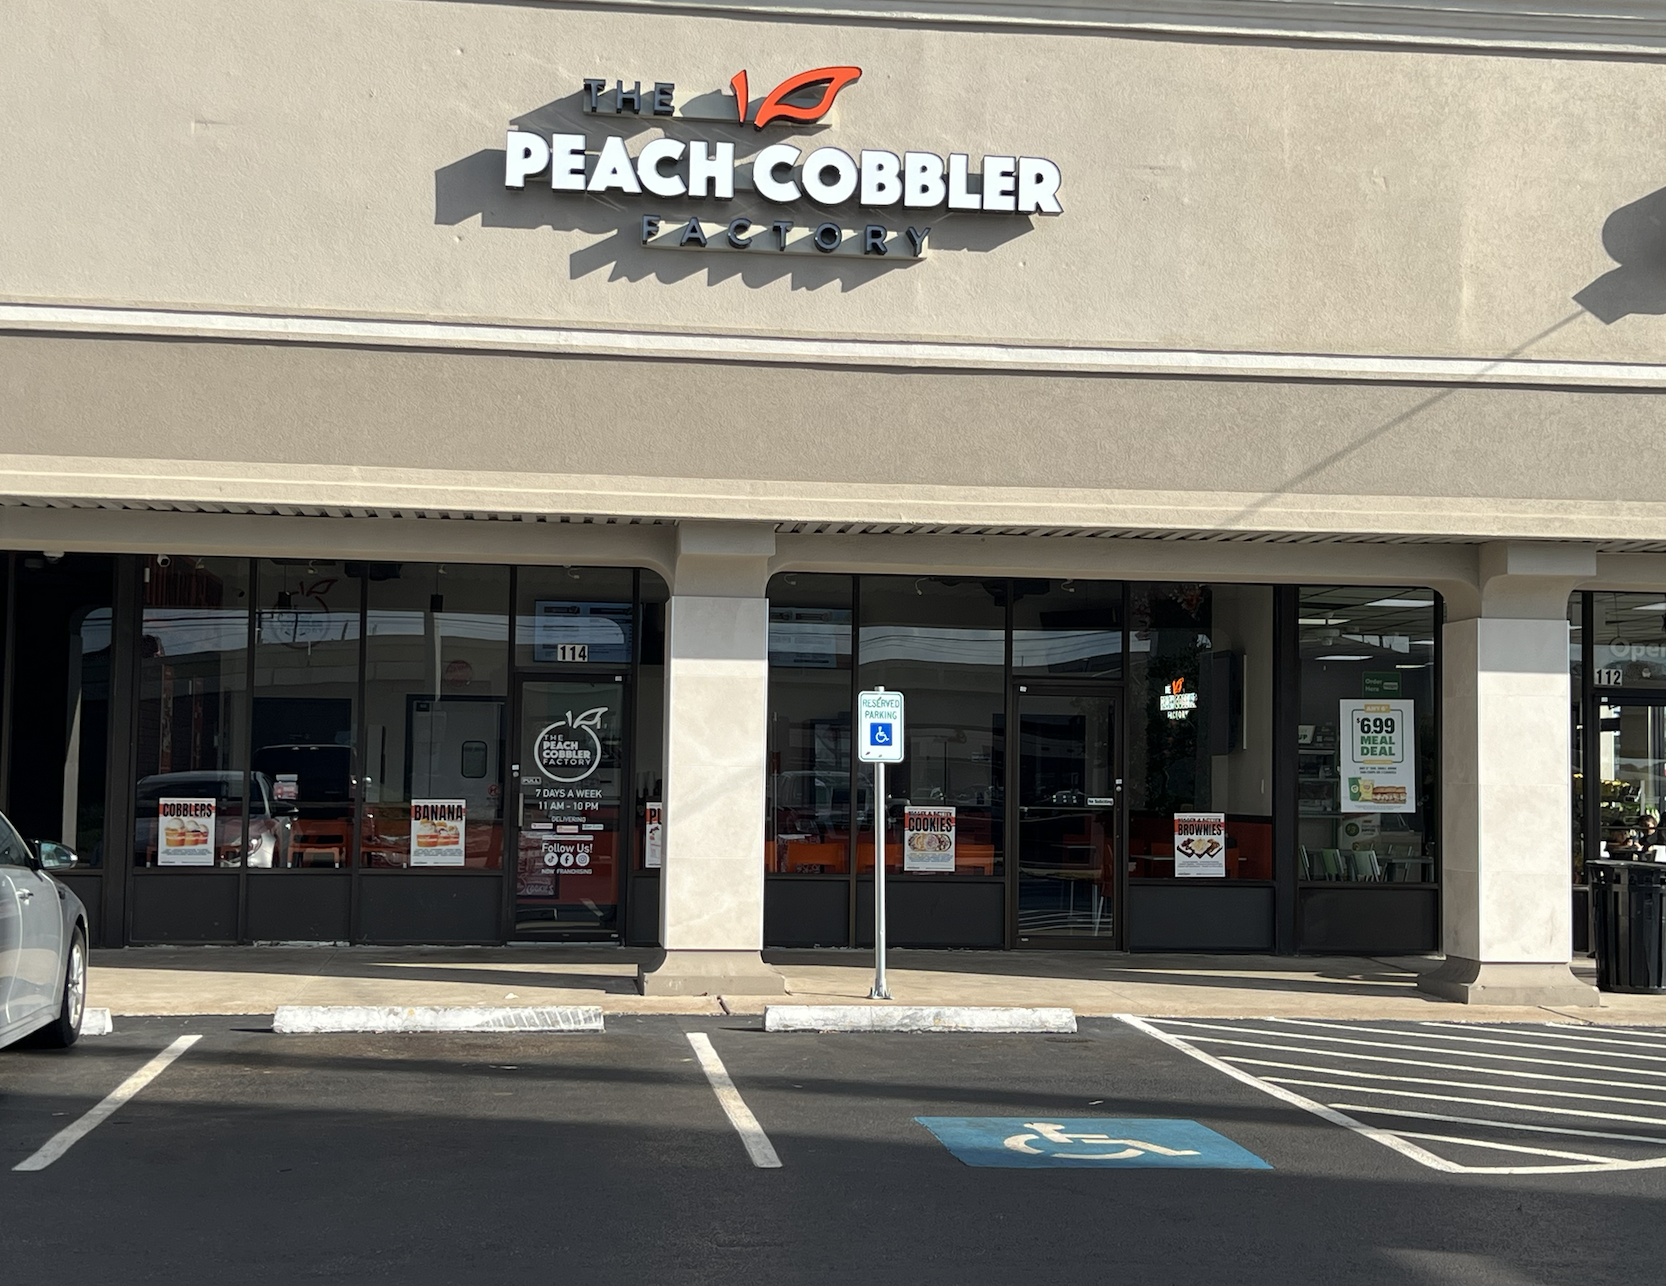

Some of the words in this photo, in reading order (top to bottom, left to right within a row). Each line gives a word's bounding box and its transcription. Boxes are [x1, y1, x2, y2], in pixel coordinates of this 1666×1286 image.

[583, 78, 675, 115] THE
[505, 129, 735, 199] PEACH
[752, 143, 1064, 215] COBBLER
[641, 214, 932, 257] FACTORY
[559, 645, 588, 661] 114
[1596, 669, 1621, 685] 112
[862, 698, 900, 709] RESERVED
[864, 710, 897, 720] PARKING
[543, 741, 578, 750] PEACH
[1360, 735, 1395, 745] MEAL
[542, 750, 591, 758] COBBLER
[1360, 746, 1395, 756] DEAL
[535, 789, 541, 797] 7
[543, 789, 566, 798] DAYS
[567, 789, 574, 798] A
[575, 789, 602, 798] WEEK
[162, 803, 212, 818] COBBLERS
[538, 801, 547, 810] 11
[550, 801, 564, 810] AM
[573, 802, 583, 810] 10
[584, 802, 599, 811] PM
[414, 804, 463, 821] BANANA
[908, 817, 952, 832] COOKIES
[1178, 823, 1222, 836] BROWNIES
[541, 843, 575, 852] Follow
[576, 843, 593, 853] Us!
